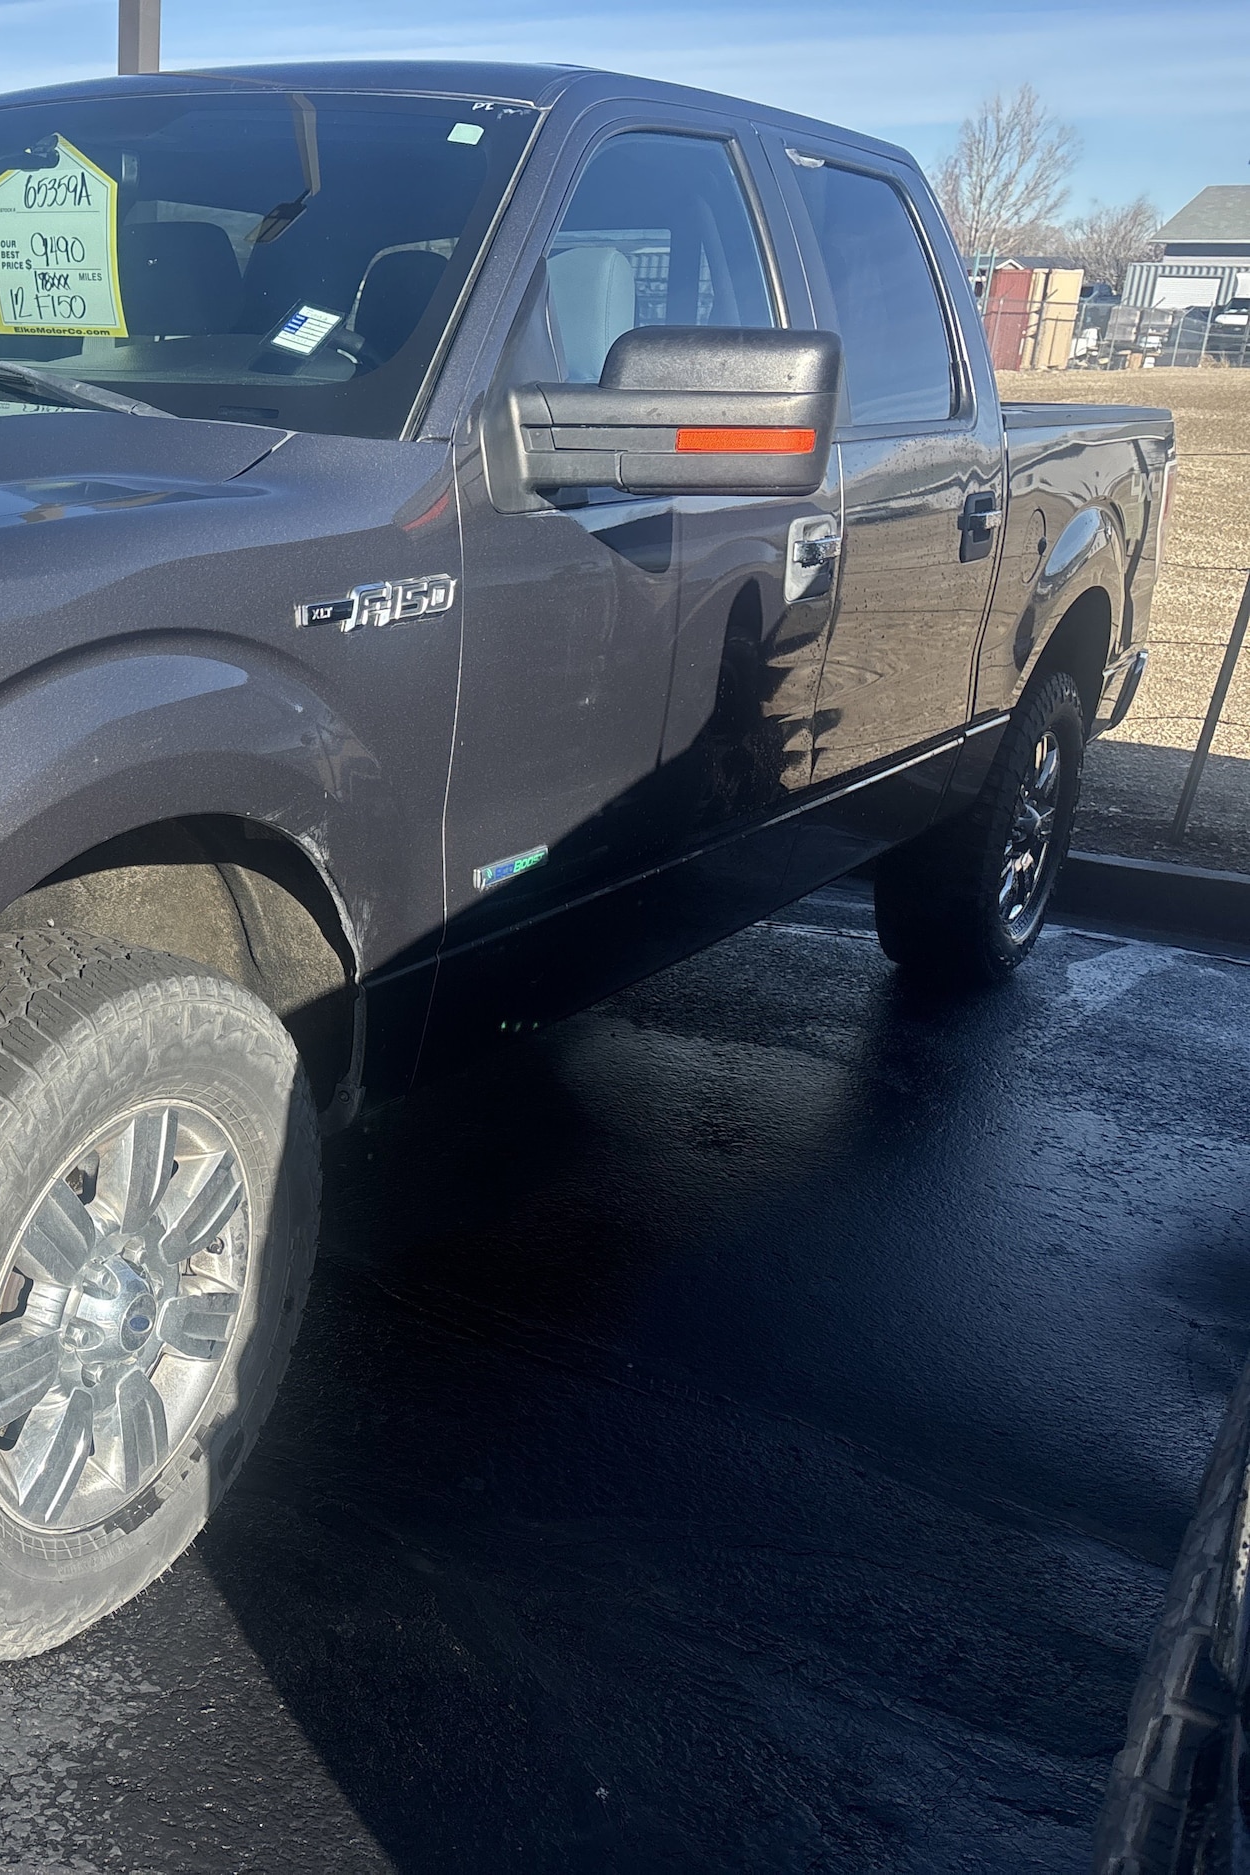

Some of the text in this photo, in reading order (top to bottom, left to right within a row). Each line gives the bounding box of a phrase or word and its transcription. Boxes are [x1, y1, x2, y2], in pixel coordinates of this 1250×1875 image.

[23, 172, 91, 209] 65359A
[0, 240, 17, 249] OUR
[30, 232, 85, 267] 9490
[1, 250, 20, 259] BEST
[1, 261, 24, 270] PRICE
[78, 272, 103, 281] MILES
[10, 286, 86, 320] 12 F150
[14, 326, 111, 336] ElkoMotorCo.com
[311, 606, 334, 620] XLT
